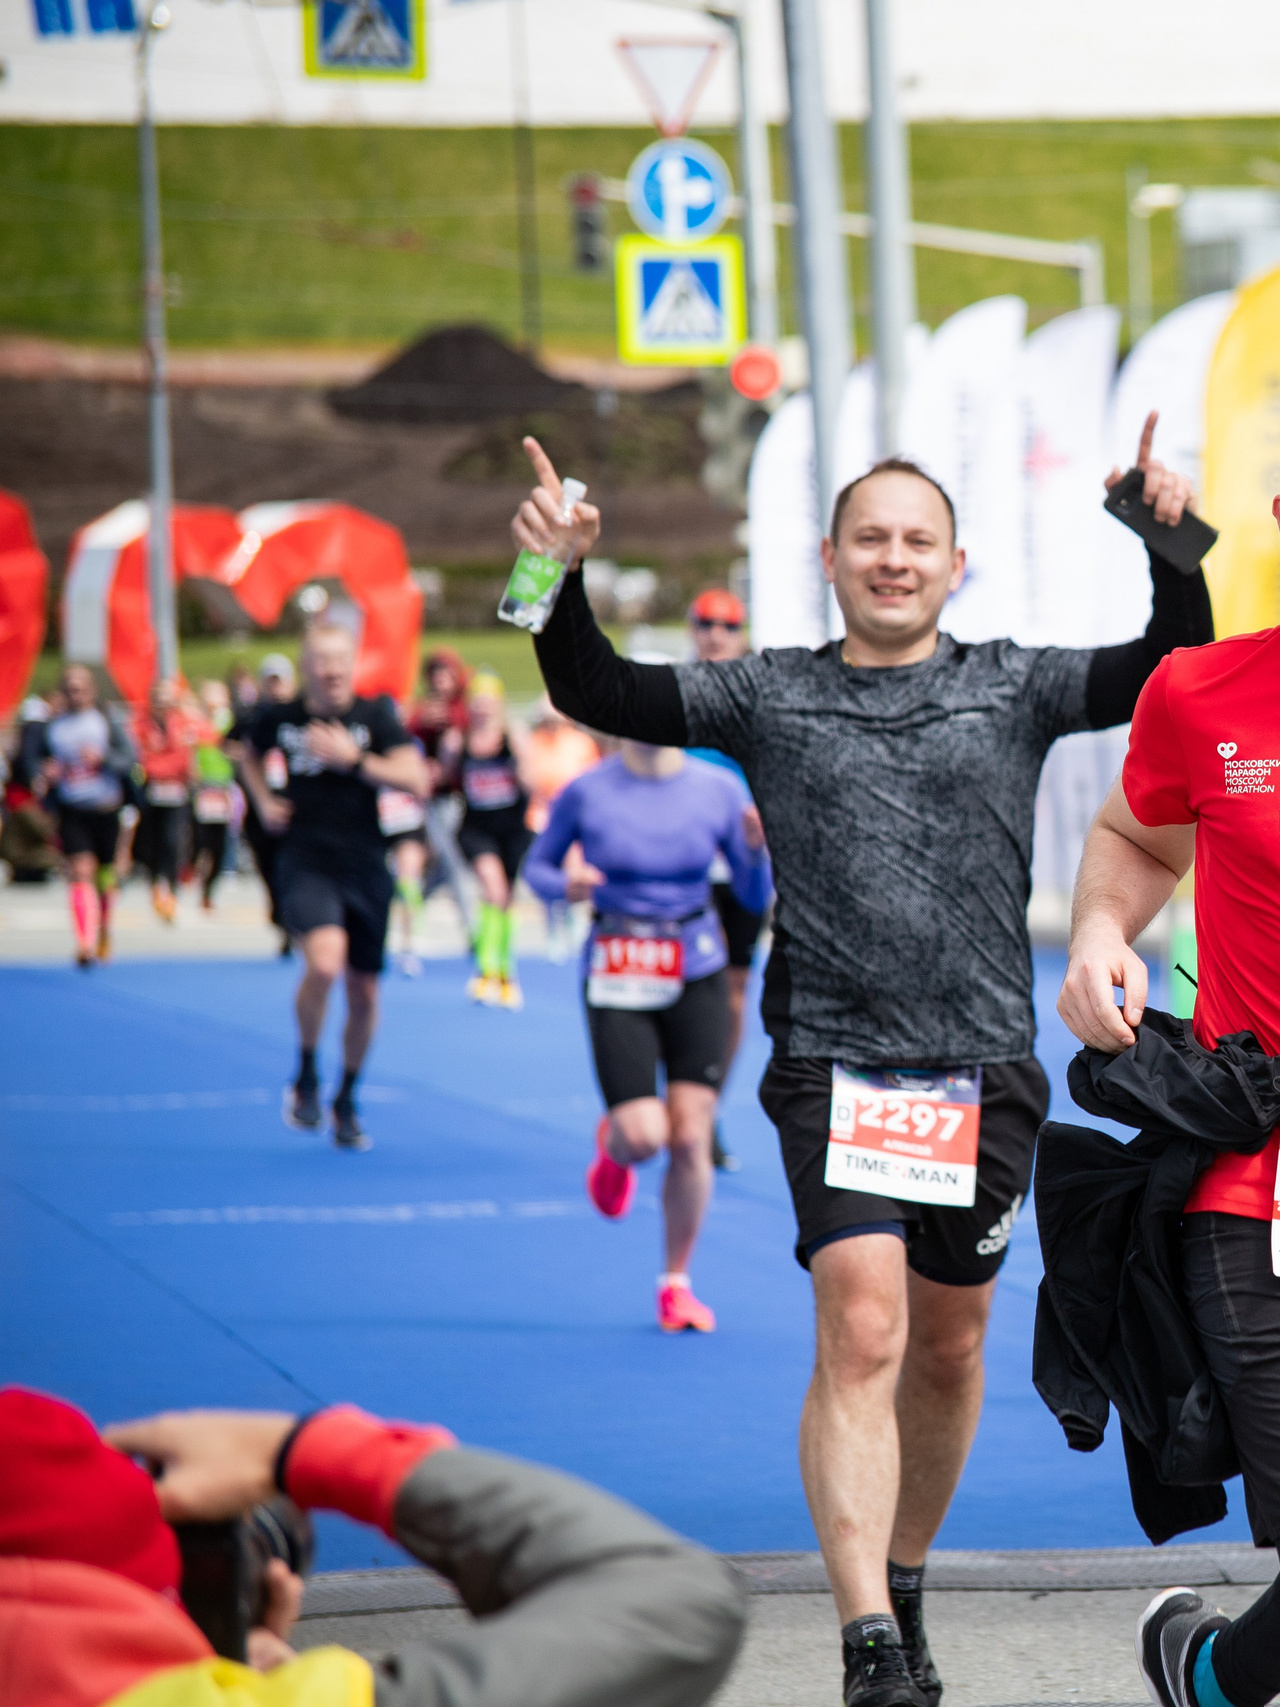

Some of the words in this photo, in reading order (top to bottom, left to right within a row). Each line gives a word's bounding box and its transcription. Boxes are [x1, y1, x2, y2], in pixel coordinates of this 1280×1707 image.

[1224, 767, 1271, 777] МАРАФОН
[1225, 776, 1266, 786] MOSCOW
[1226, 785, 1276, 795] MARATHON
[836, 1106, 850, 1121] D
[857, 1098, 965, 1142] 2297
[844, 1153, 958, 1186] TIMEMAN
